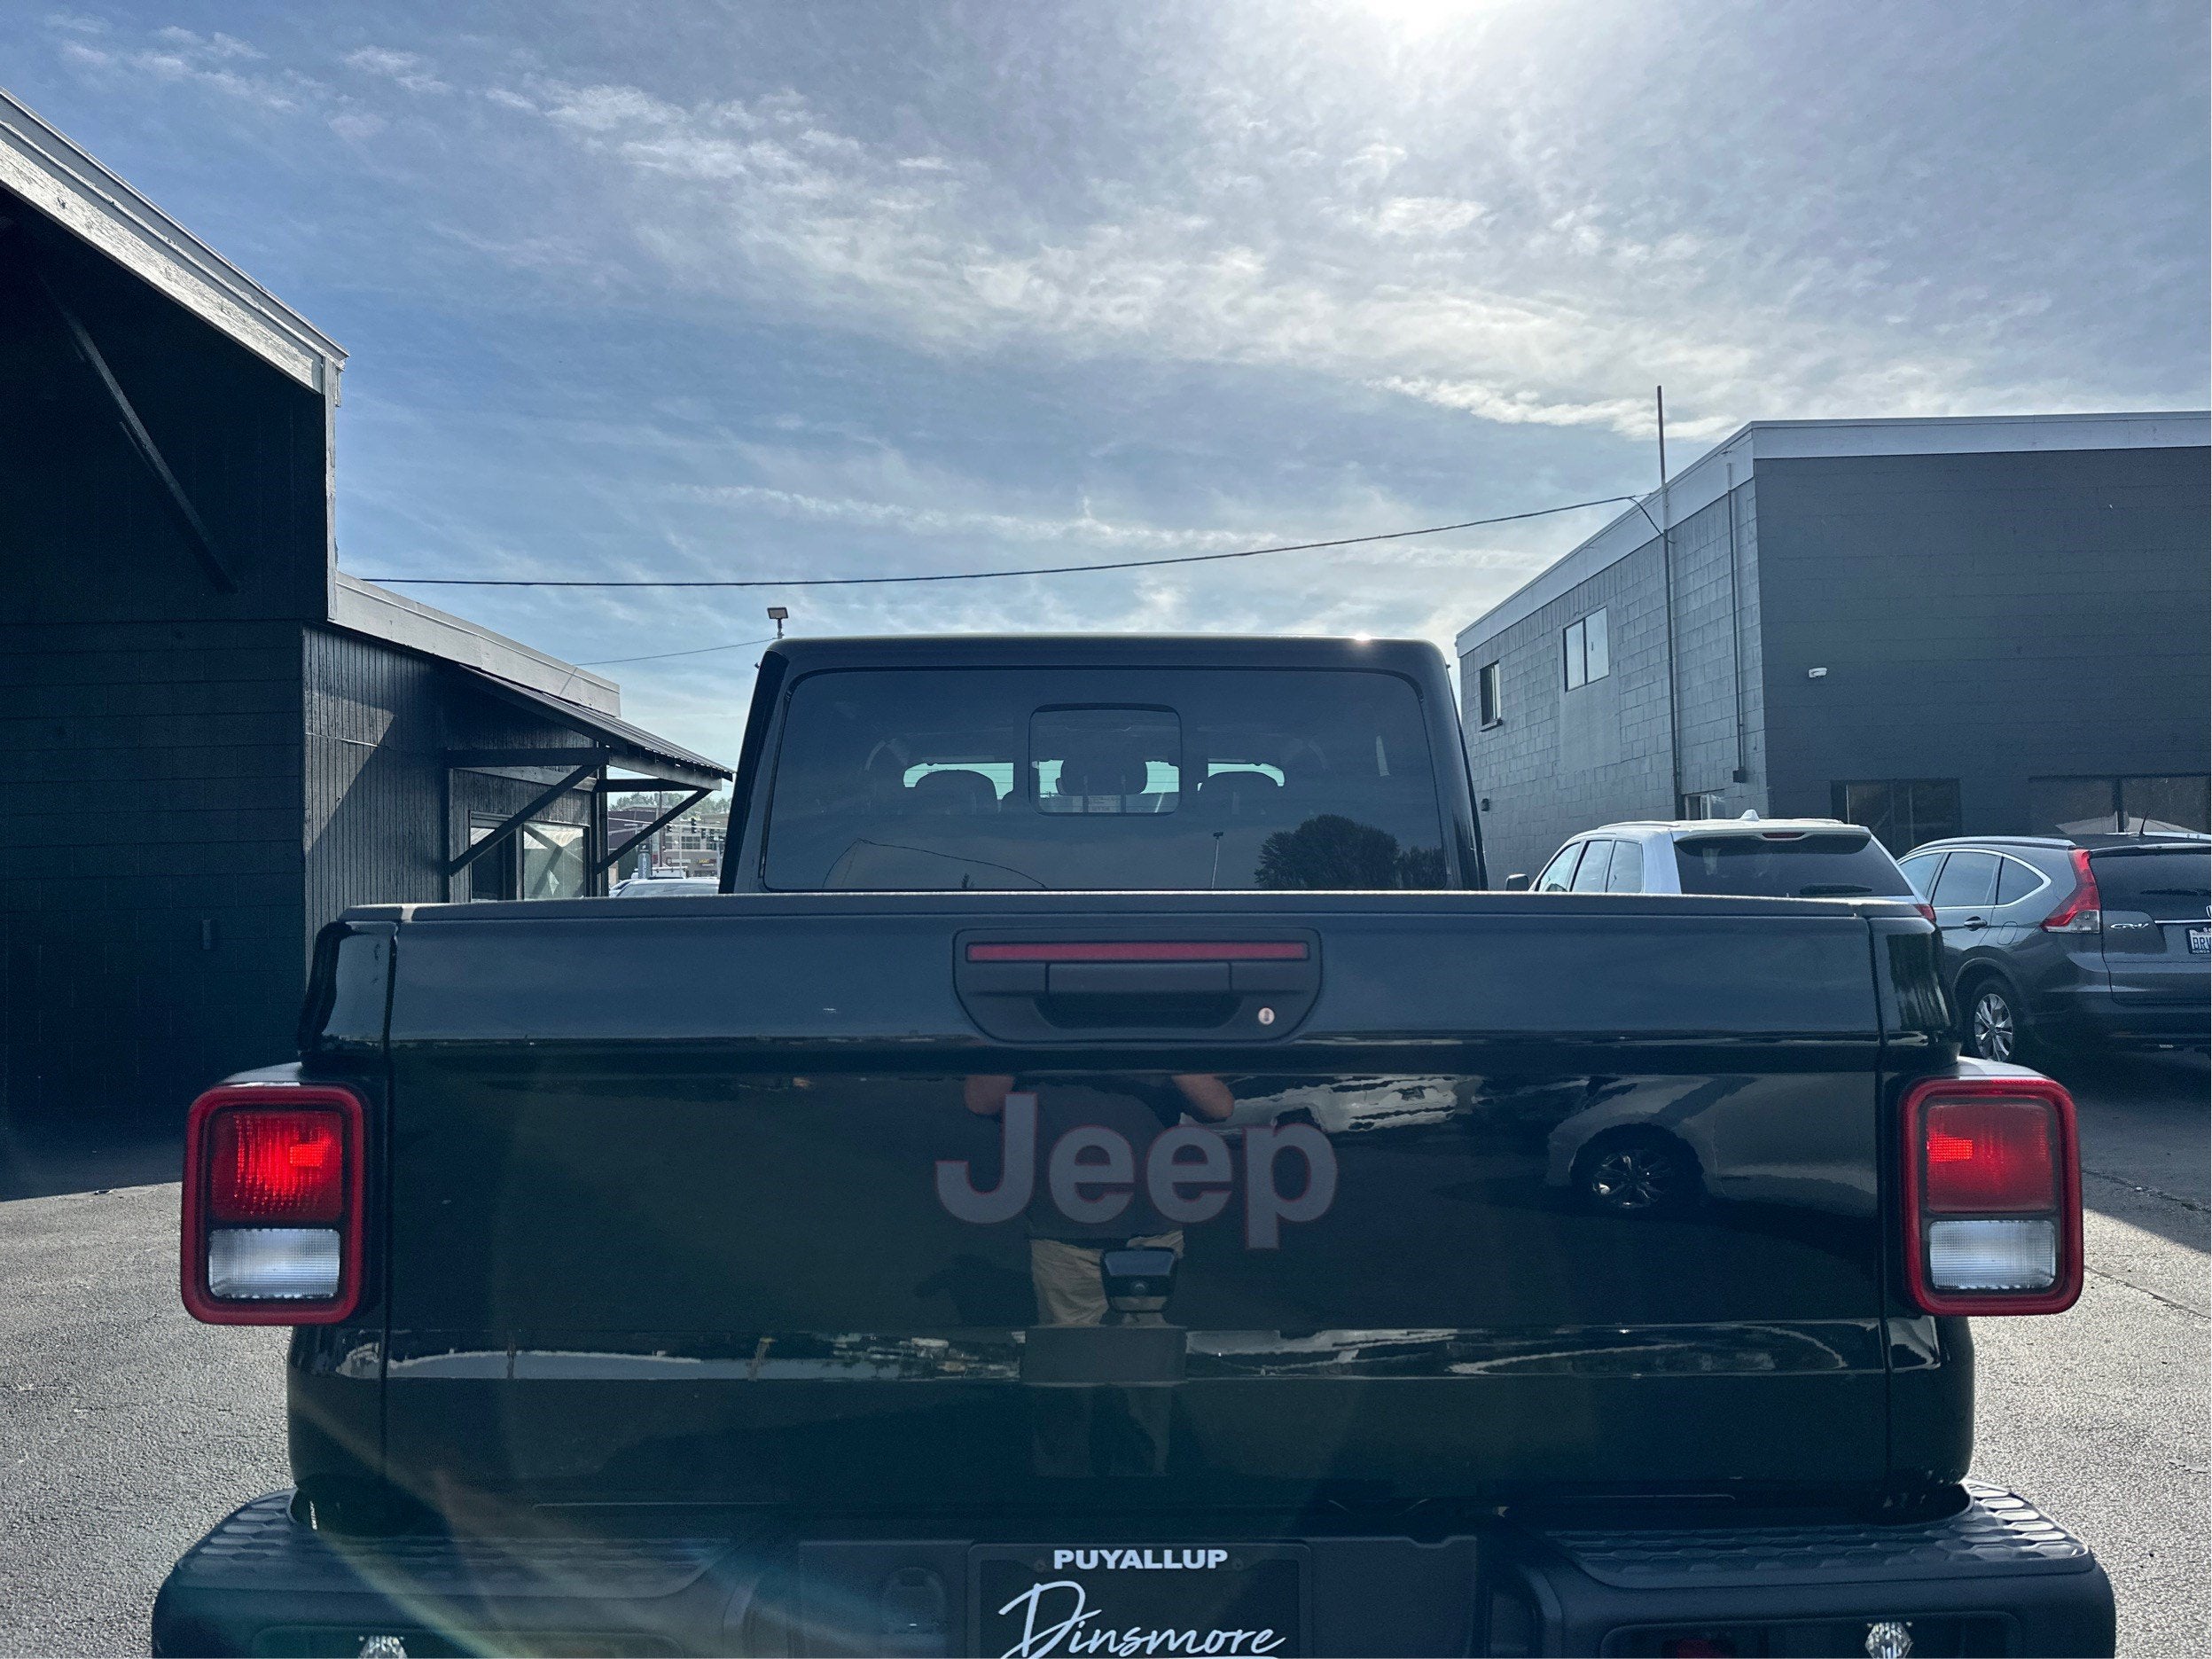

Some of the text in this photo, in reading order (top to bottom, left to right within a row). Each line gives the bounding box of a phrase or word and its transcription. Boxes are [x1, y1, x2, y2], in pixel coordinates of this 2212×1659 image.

[934, 1092, 1339, 1249] Jeep
[1053, 1549, 1228, 1569] PUYALLUP
[998, 1580, 1286, 1659] Dinsmore
